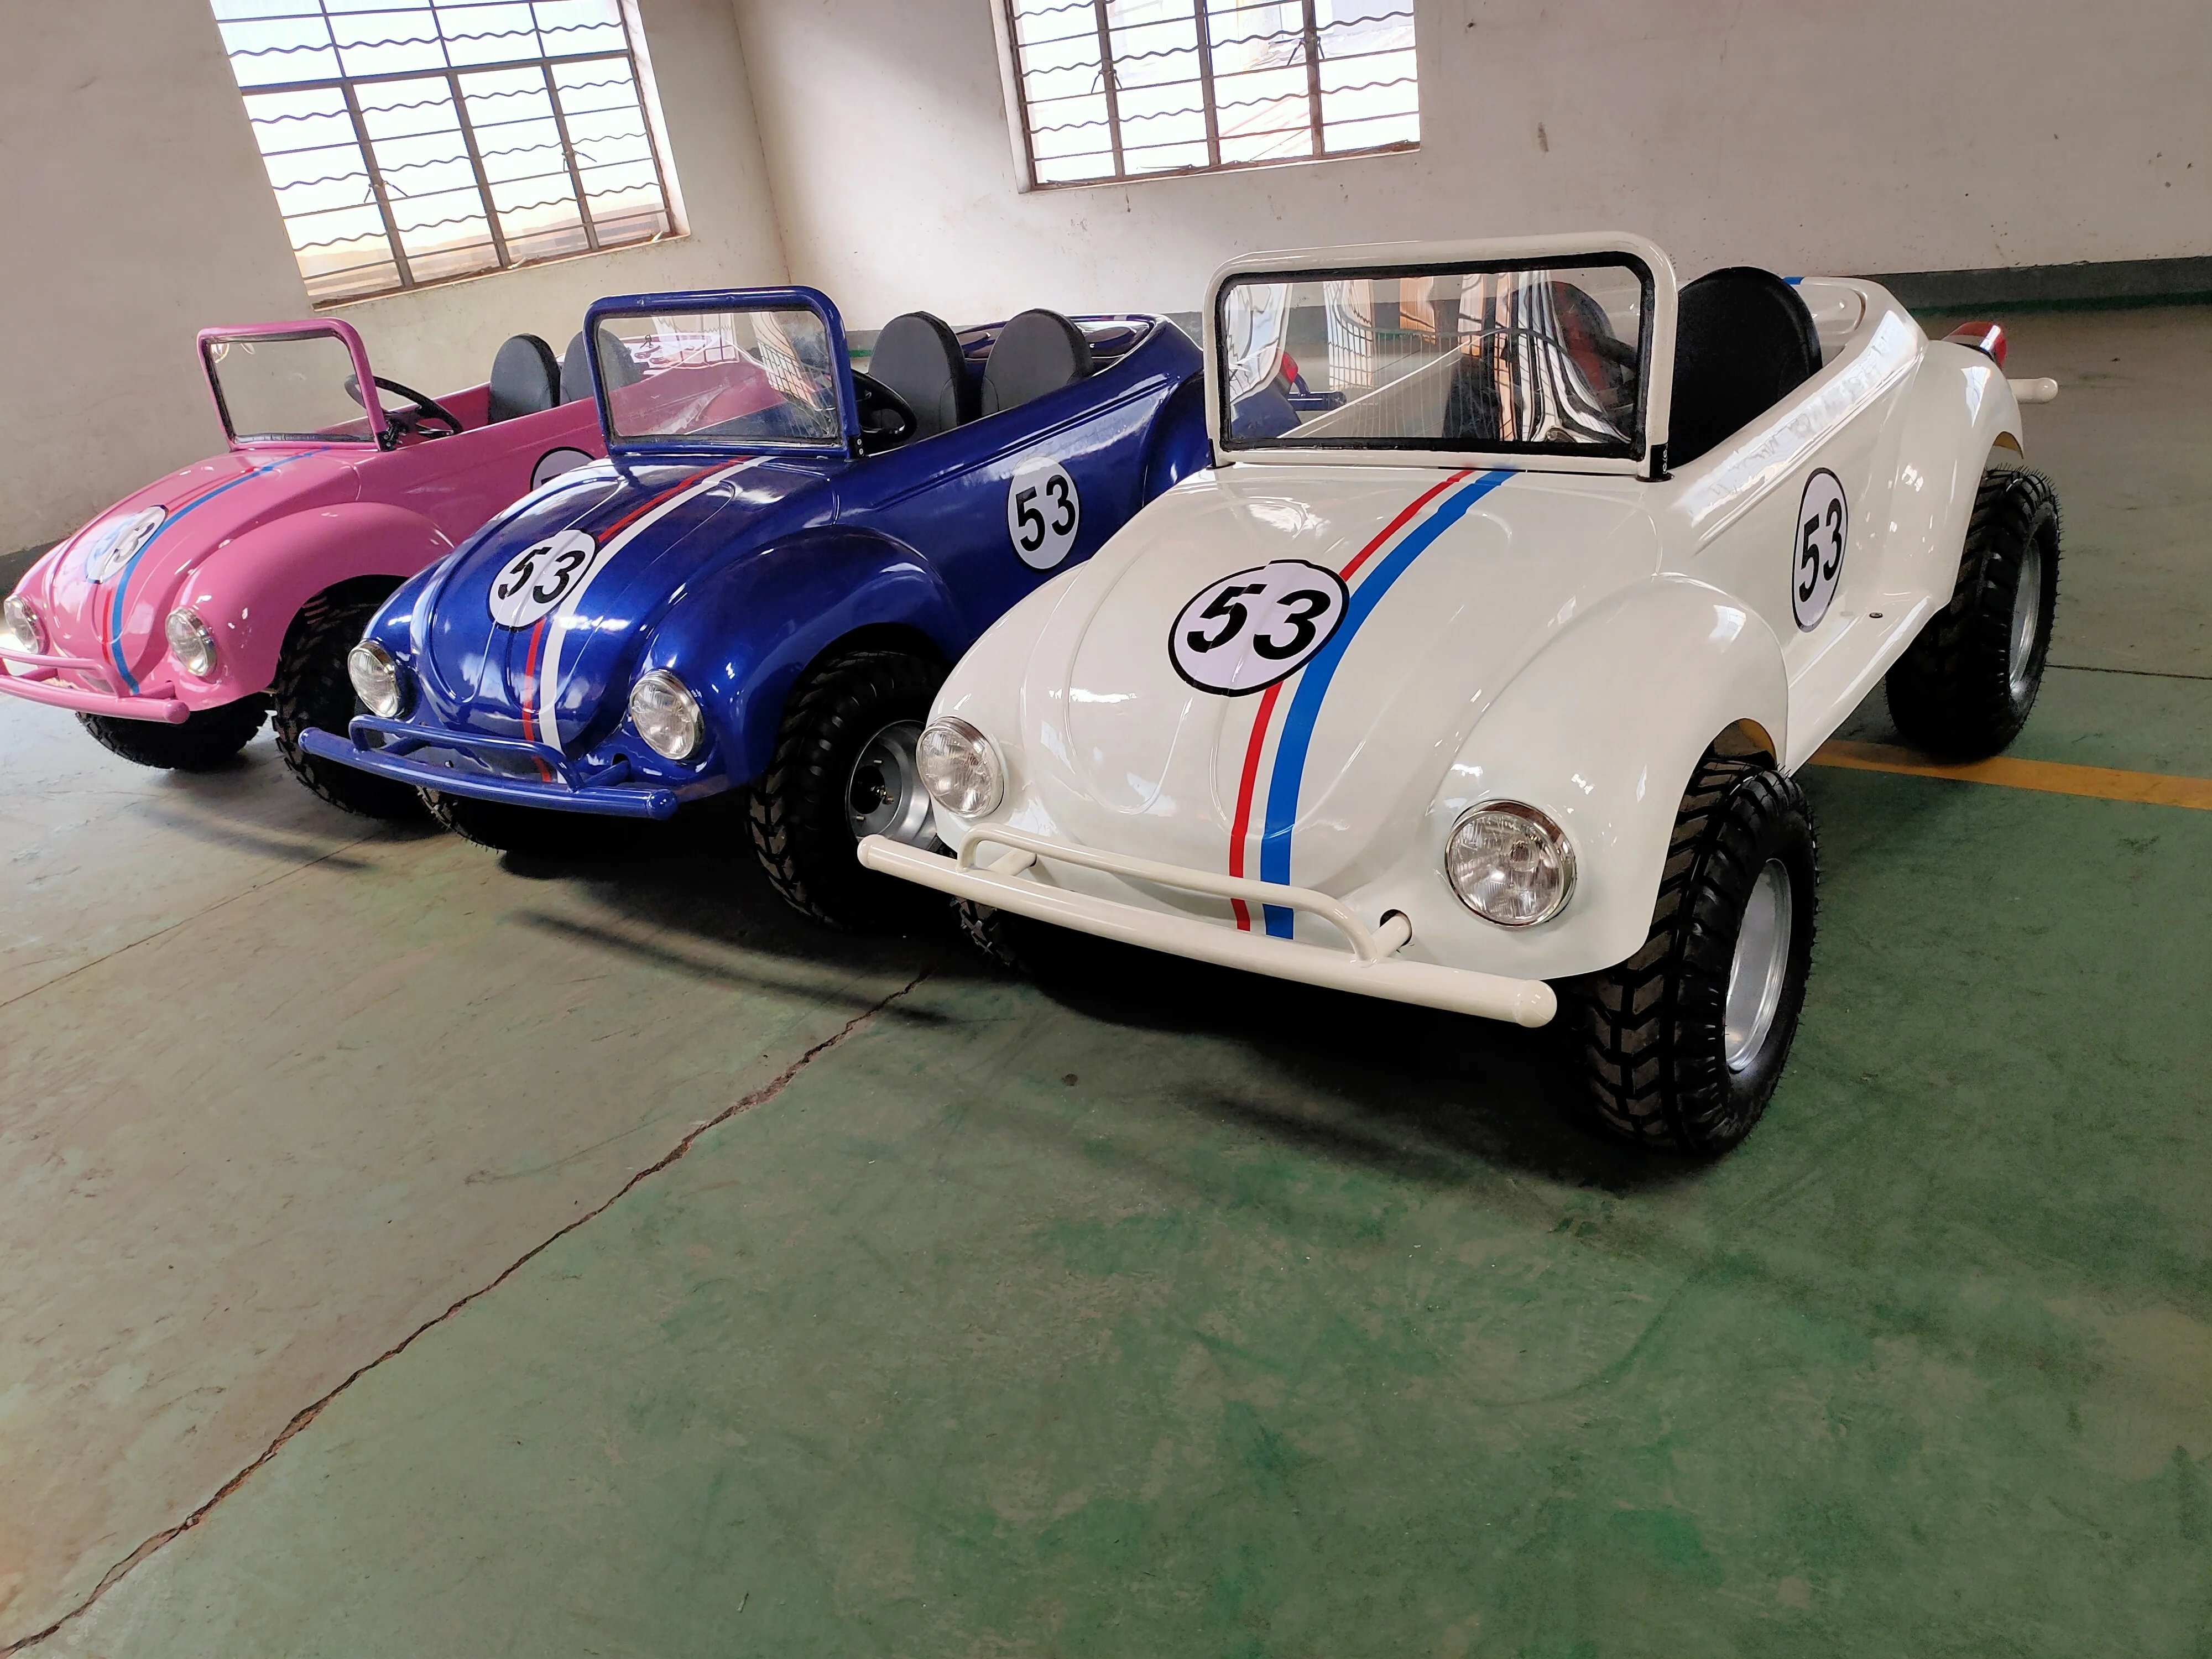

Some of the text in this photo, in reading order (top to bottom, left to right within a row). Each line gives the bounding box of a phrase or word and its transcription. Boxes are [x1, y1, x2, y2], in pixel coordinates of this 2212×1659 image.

[1016, 474, 1076, 552] 53
[1799, 498, 1843, 603] 53
[498, 546, 586, 604] 53
[1187, 583, 1332, 660] 53
